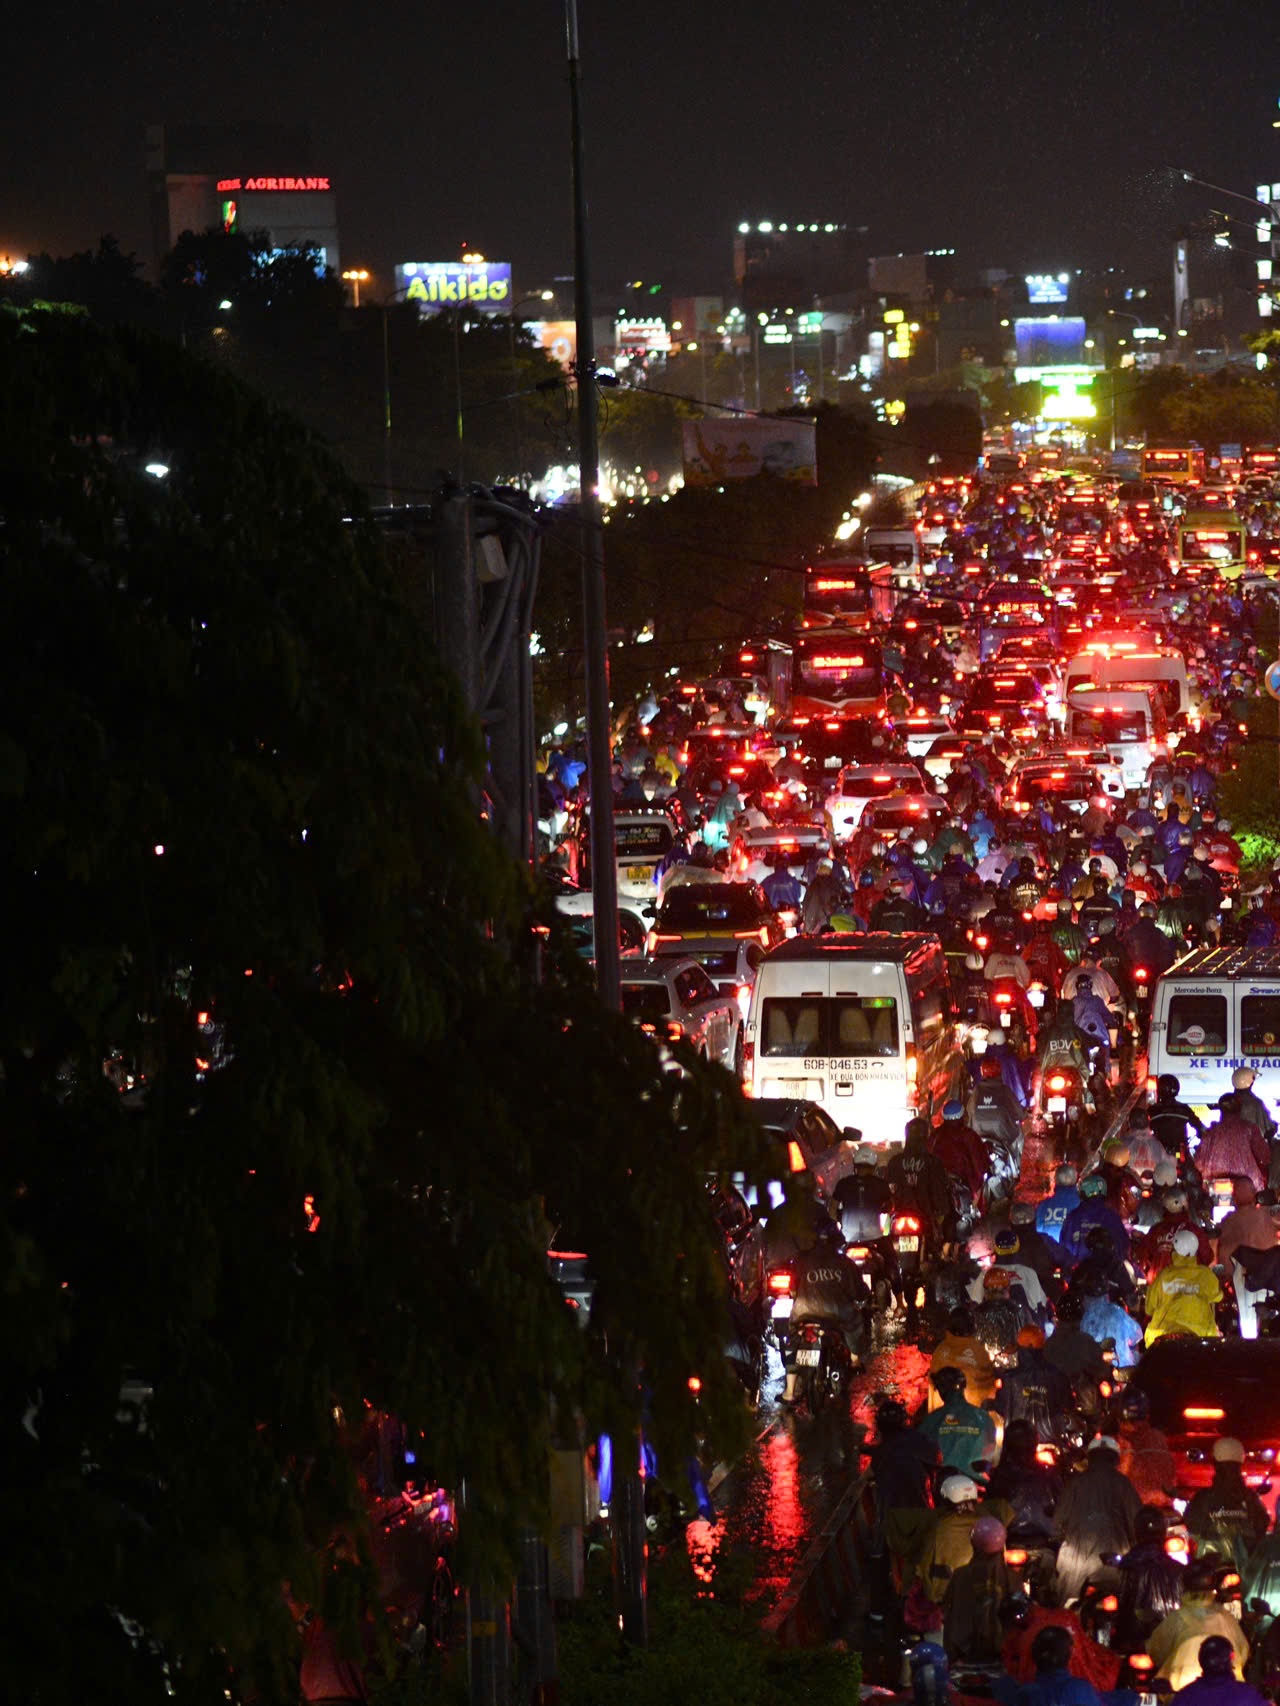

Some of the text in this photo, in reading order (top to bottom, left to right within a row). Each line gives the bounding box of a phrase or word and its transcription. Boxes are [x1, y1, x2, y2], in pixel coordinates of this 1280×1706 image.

[245, 178, 329, 190] AGRIBANK
[407, 275, 508, 302] Aikido
[1190, 1058, 1209, 1068] XE
